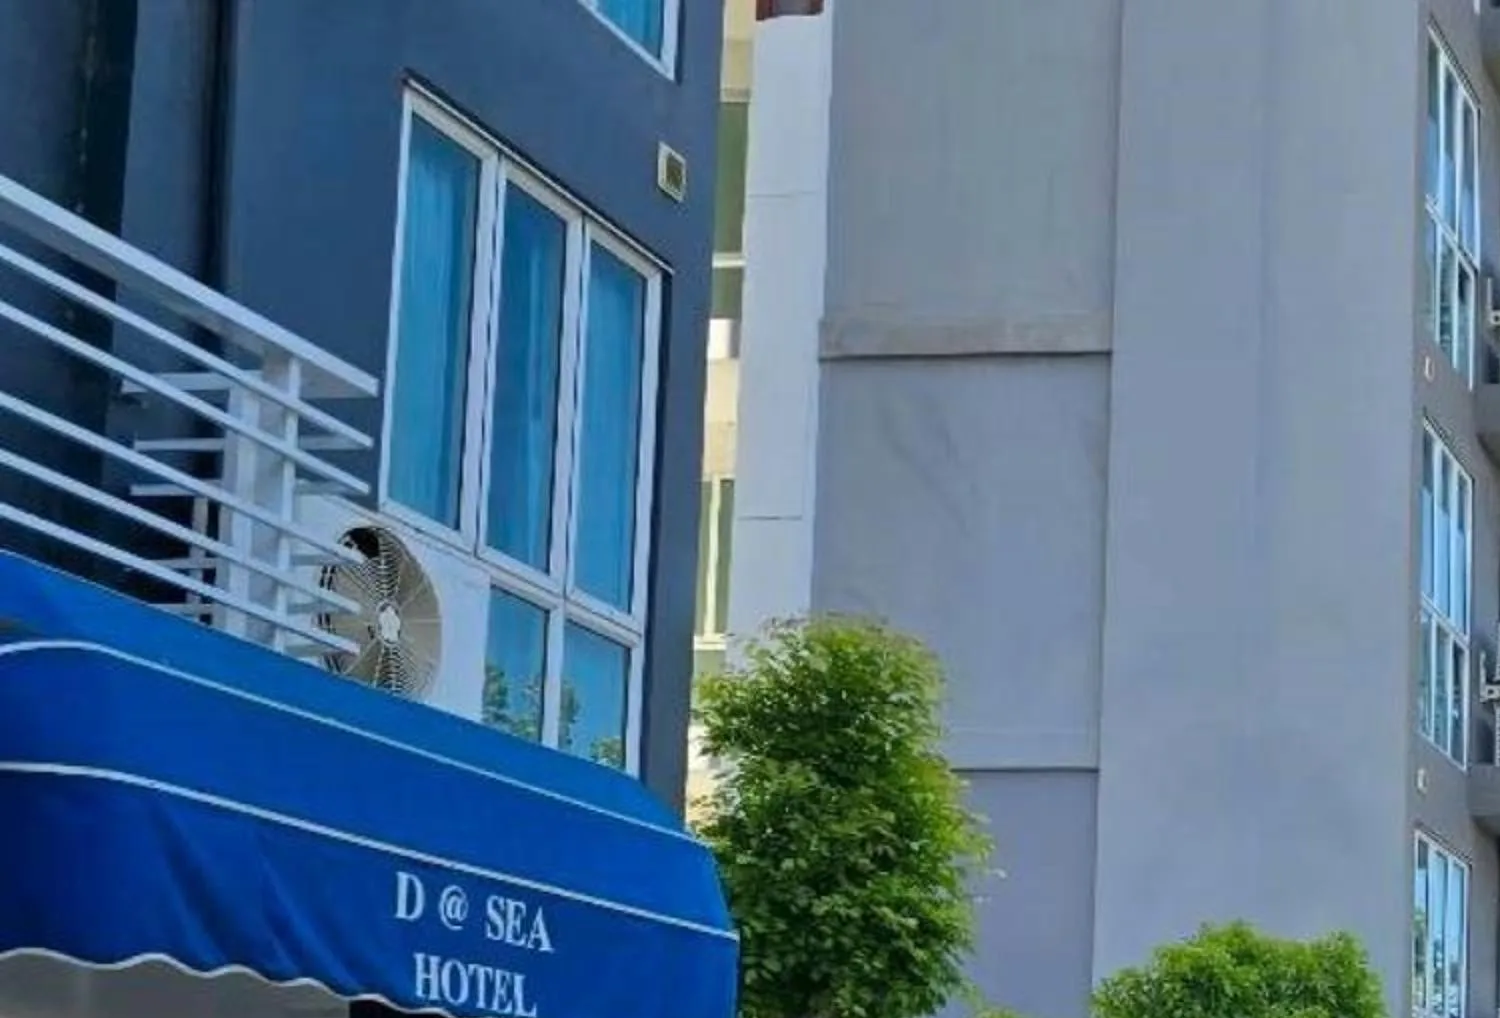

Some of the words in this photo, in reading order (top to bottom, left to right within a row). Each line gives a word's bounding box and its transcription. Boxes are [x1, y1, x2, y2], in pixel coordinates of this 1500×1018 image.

[395, 871, 426, 921] D
[439, 884, 470, 932] @
[485, 895, 555, 953] SEA
[413, 952, 538, 1018] HOTEL
